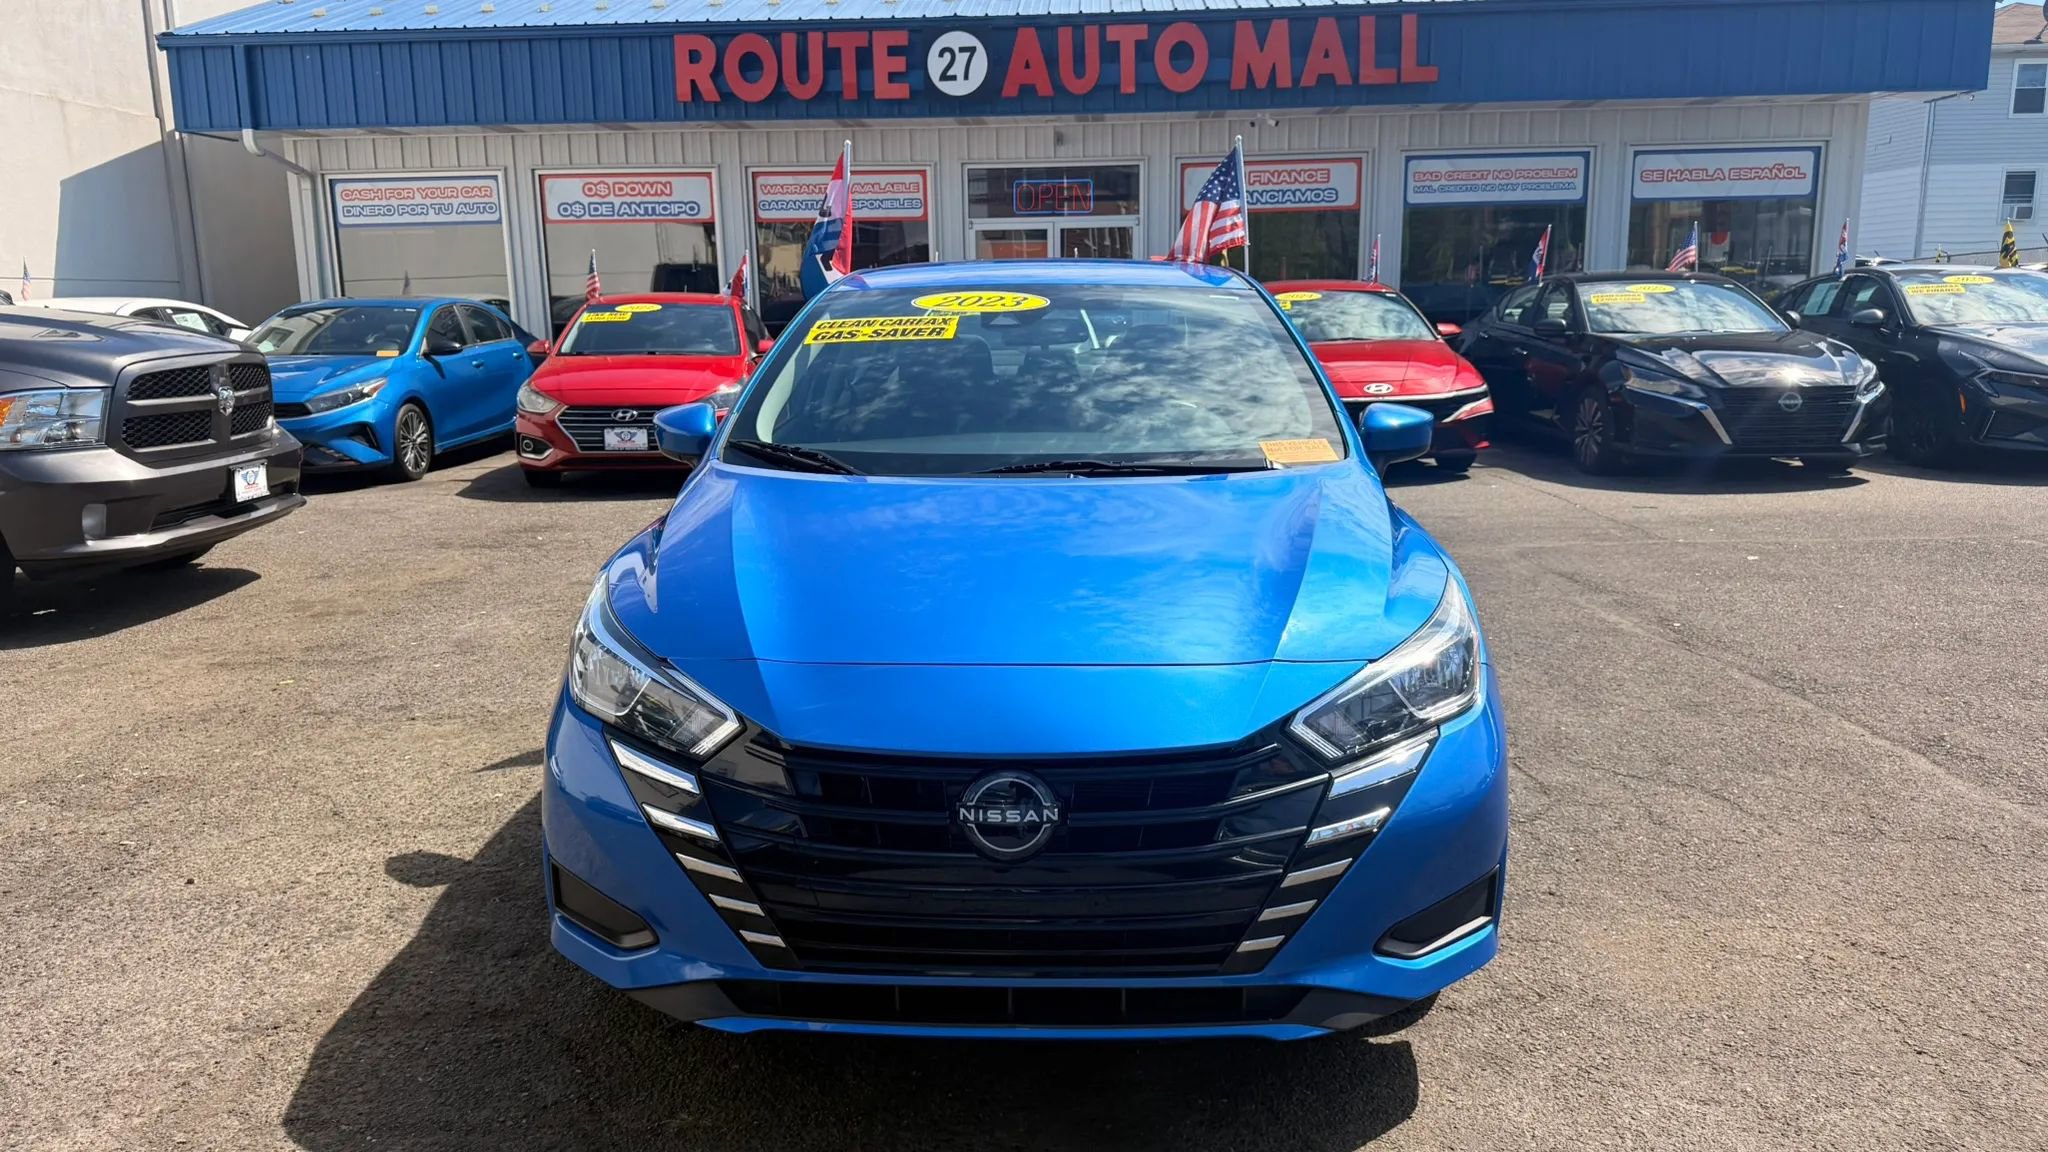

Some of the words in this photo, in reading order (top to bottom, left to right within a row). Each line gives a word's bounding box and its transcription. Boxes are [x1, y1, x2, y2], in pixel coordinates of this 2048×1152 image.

[673, 30, 910, 102] ROUTE
[937, 46, 978, 82] 27
[1001, 22, 1209, 98] AUTO
[1230, 13, 1439, 90] MALL
[1248, 169, 1330, 186] FINANCE
[1413, 171, 1442, 182] BAD
[1444, 170, 1491, 181] CREDIT
[1492, 169, 1513, 181] NO
[1515, 168, 1578, 180] PROBLEM
[1640, 169, 1666, 183] SE
[1667, 168, 1725, 182] HABLA
[1728, 163, 1806, 180] ESPAÑOL
[341, 189, 383, 201] CASH
[384, 188, 415, 200] FOR
[416, 187, 458, 199] YOUR
[459, 186, 493, 198] CAR
[613, 181, 672, 197] DOWN
[761, 183, 828, 196] WARRANT
[851, 182, 920, 195] AVAILABLE
[1413, 185, 1436, 194] MAL
[1438, 184, 1479, 193] CREDITO
[1481, 184, 1496, 192] NO
[1499, 183, 1520, 192] HAY
[1521, 182, 1577, 192] PROBLEMA
[851, 198, 922, 210] SPONIBLES
[1017, 183, 1091, 211] OPEN
[342, 204, 396, 217] DINERO
[397, 204, 428, 216] POR
[430, 203, 453, 215] TU
[456, 202, 498, 214] AUTO
[588, 202, 615, 217] DE
[616, 201, 701, 217] ANTICIPO
[933, 295, 1028, 309] 2023
[816, 319, 878, 330] CLEAN
[878, 317, 952, 328] CARFAX
[812, 327, 945, 341] GAS-SAVER
[960, 807, 1058, 822] NISSAN
